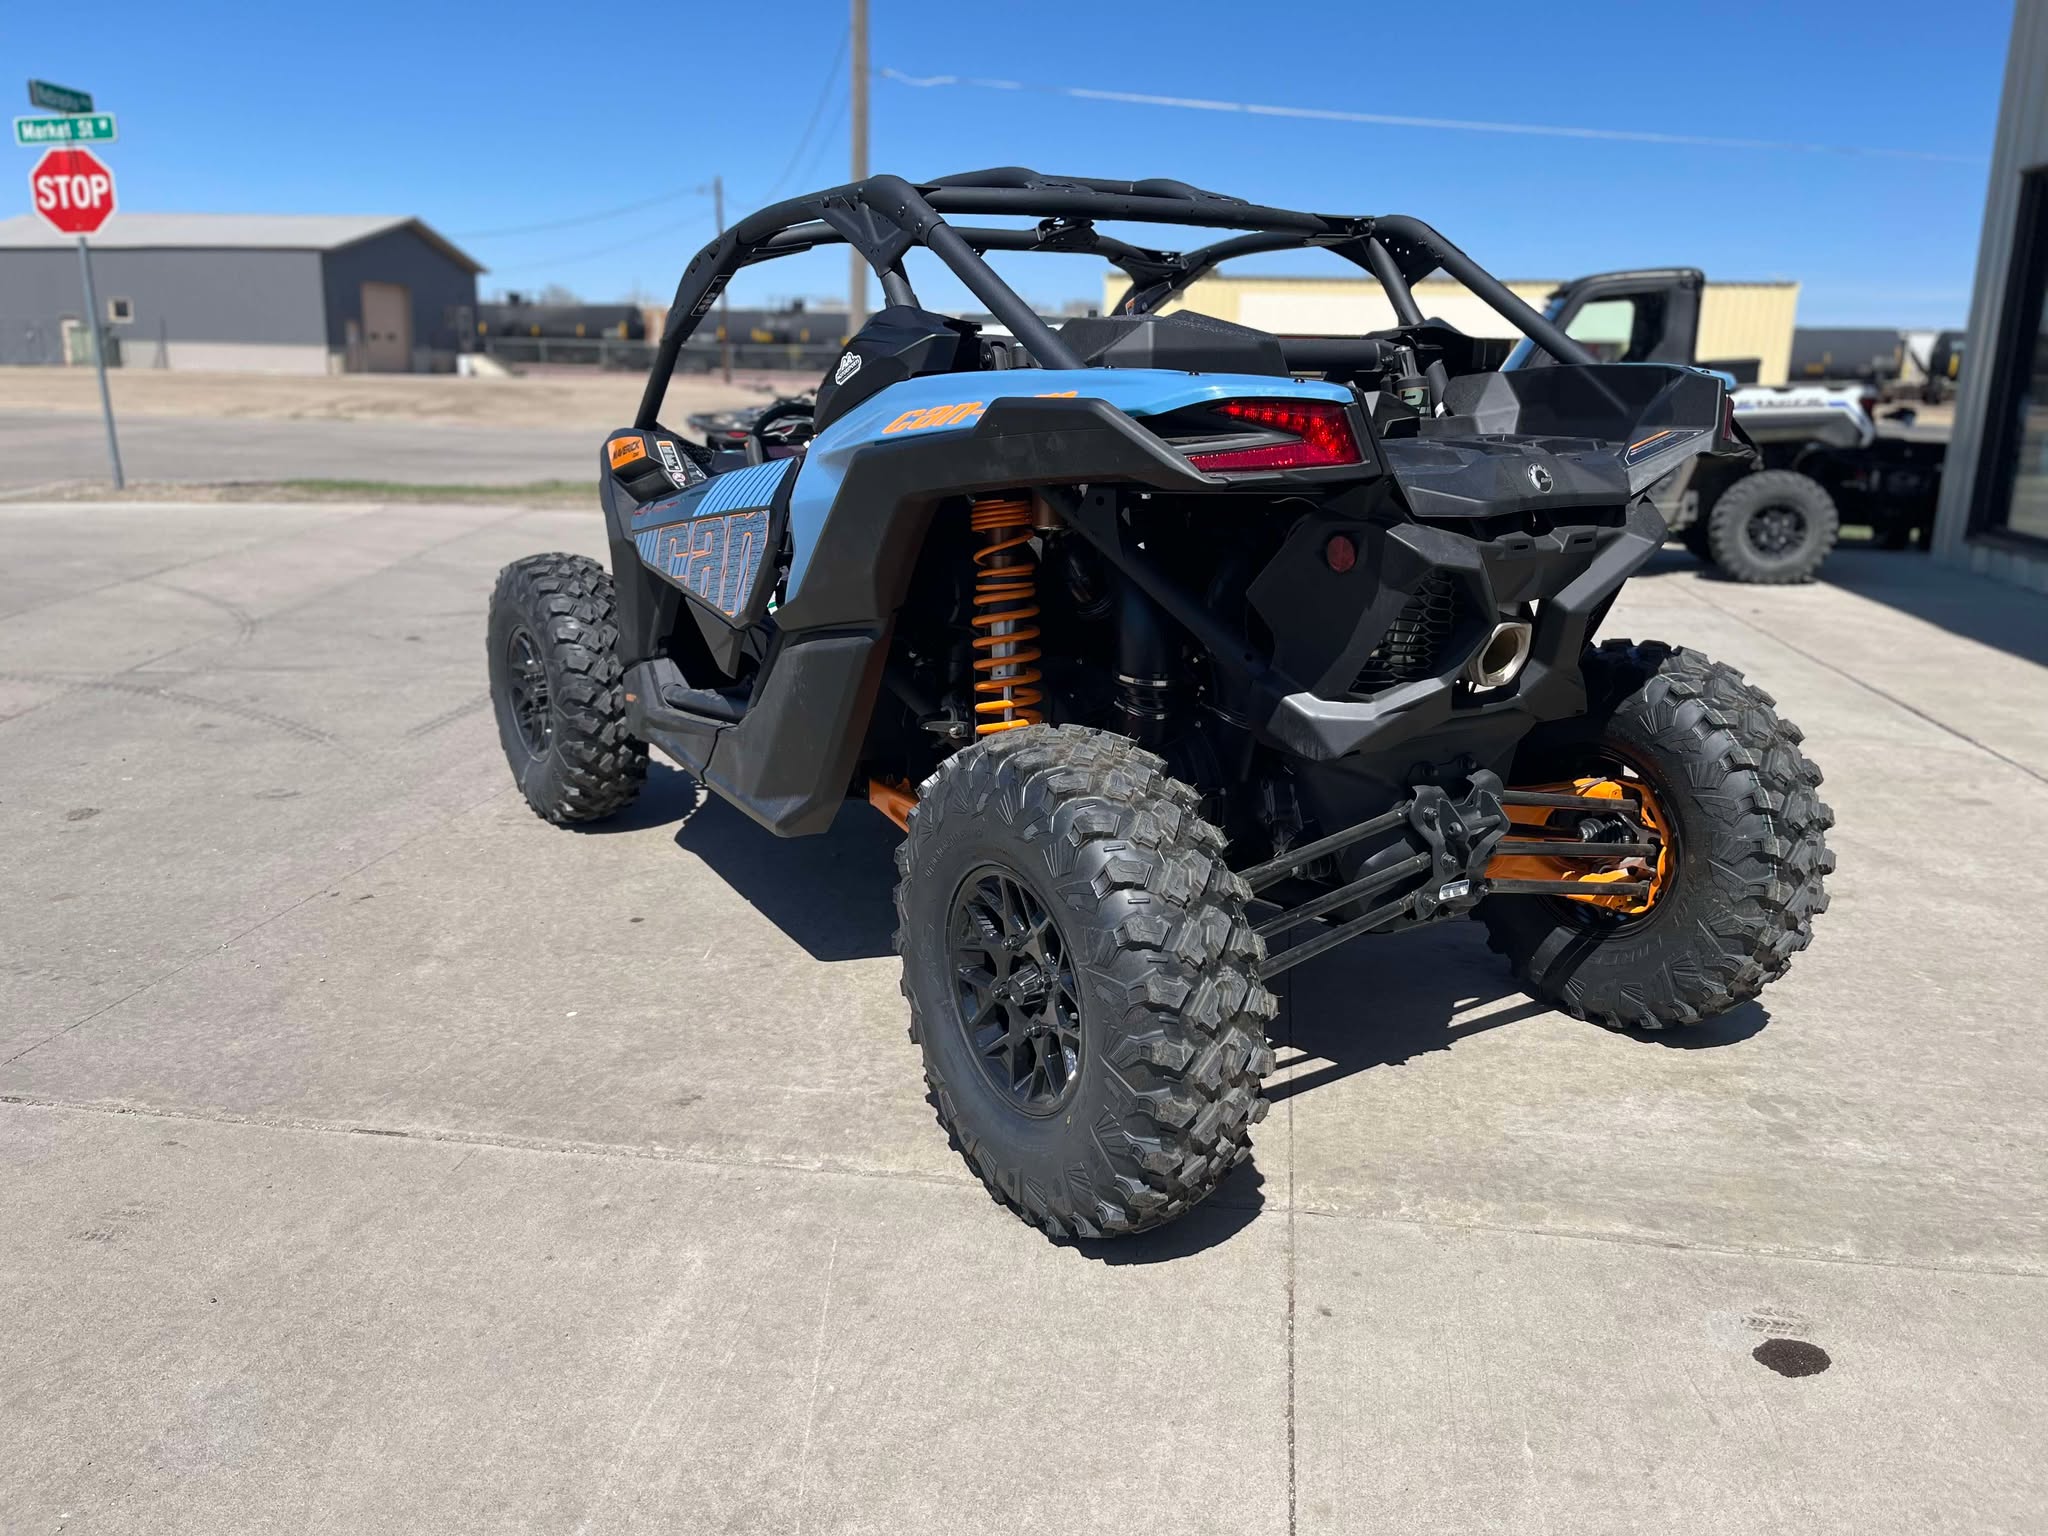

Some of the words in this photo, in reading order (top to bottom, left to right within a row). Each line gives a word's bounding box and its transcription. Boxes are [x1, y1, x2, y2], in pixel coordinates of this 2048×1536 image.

[21, 120, 72, 141] Market
[77, 118, 94, 138] St
[37, 175, 109, 210] STOP
